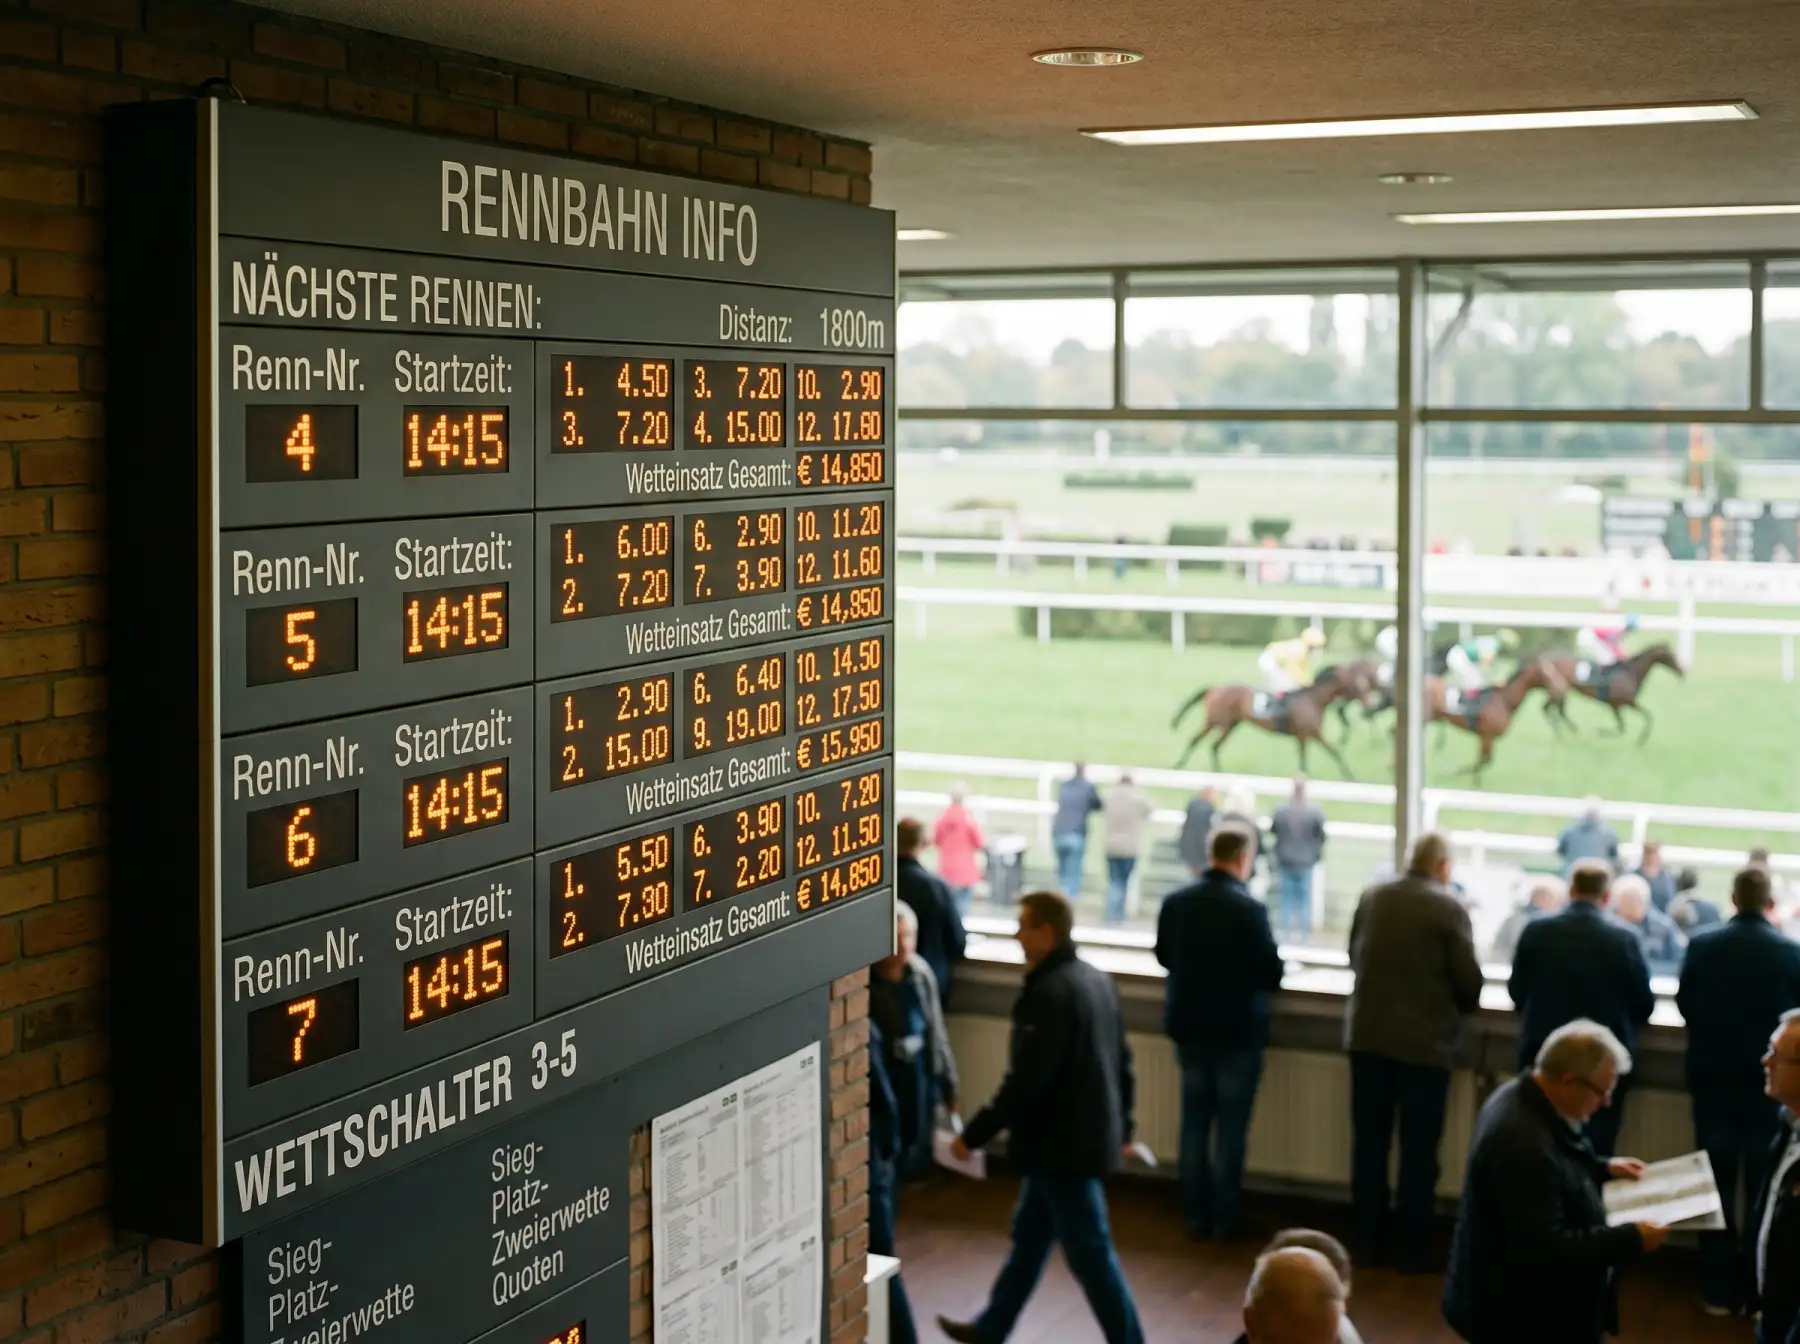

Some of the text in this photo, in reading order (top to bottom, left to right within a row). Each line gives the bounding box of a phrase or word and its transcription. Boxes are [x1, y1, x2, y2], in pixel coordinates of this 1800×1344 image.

[442, 161, 757, 266] RENNBAHN INFO
[234, 252, 541, 329] NÄCHSTE RENNEN:
[720, 304, 884, 348] Distanz: 1800m
[234, 345, 364, 390] Renn-Nr.
[395, 350, 511, 393] Startzeit:
[565, 361, 668, 397] 1. 4.50
[695, 367, 780, 398] 3. 7.20
[798, 369, 881, 400] 10. 2.90
[286, 414, 314, 471] 4
[408, 414, 503, 468] 14:15
[563, 411, 668, 445] 3. 7.20
[695, 411, 780, 443] 4. 15.00
[798, 412, 821, 441] 12.
[626, 459, 790, 493] Wetteinsatz Gesamt:
[797, 452, 881, 484] € 14,850
[565, 522, 668, 564] 1. 6.00
[695, 514, 780, 551] 6. 2.90
[798, 506, 880, 541] 10. 11.20
[234, 543, 363, 595] Renn-Nr.
[395, 532, 511, 579] Startzeit:
[695, 557, 781, 597] 7. 3.90
[798, 546, 880, 583] 12. 11.60
[563, 569, 668, 614] 2. 7.20
[797, 597, 811, 626] €
[287, 611, 315, 671] 5
[408, 592, 502, 653] 14:15
[626, 604, 790, 654] Wetteinsatz Gesamt:
[695, 658, 780, 704] 6. 6.40
[797, 640, 880, 683] 10. 14.50
[565, 679, 668, 731] 1. 2.90
[694, 701, 780, 749] 9. 19.00
[797, 680, 880, 726] 12. 17.50
[396, 709, 511, 768] Startzeit:
[563, 726, 668, 780] 2. 15.00
[797, 721, 881, 768] € 15,950
[235, 737, 363, 800] Renn-Nr.
[626, 747, 791, 814] Wetteinsatz Gesamt:
[407, 764, 502, 838] 14:15
[797, 774, 879, 825] 10. 7.20
[288, 808, 315, 867] 6
[694, 802, 780, 856] 6. 3.90
[797, 813, 880, 867] 12. 11.50
[565, 835, 668, 898] 1. 5.50
[694, 845, 780, 901] 7. 2.20
[797, 854, 880, 909] € 14,850
[396, 884, 511, 952] Startzeit:
[564, 881, 668, 946] 2. 7.30
[626, 891, 791, 974] Wetteinsatz Gesamt:
[235, 927, 363, 1003] Renn-Nr.
[408, 938, 502, 1020] 14:15
[289, 999, 315, 1061] 7
[235, 1029, 576, 1213] WETTSCHALTER 3-5
[492, 1143, 543, 1182] Sieg-
[492, 1184, 609, 1267] Zweierwette
[493, 1179, 549, 1225] Platz-
[269, 1238, 333, 1285] Sieg-
[492, 1248, 564, 1305] Quoten
[269, 1279, 339, 1333] Platz-
[270, 1283, 414, 1344] eierwette
